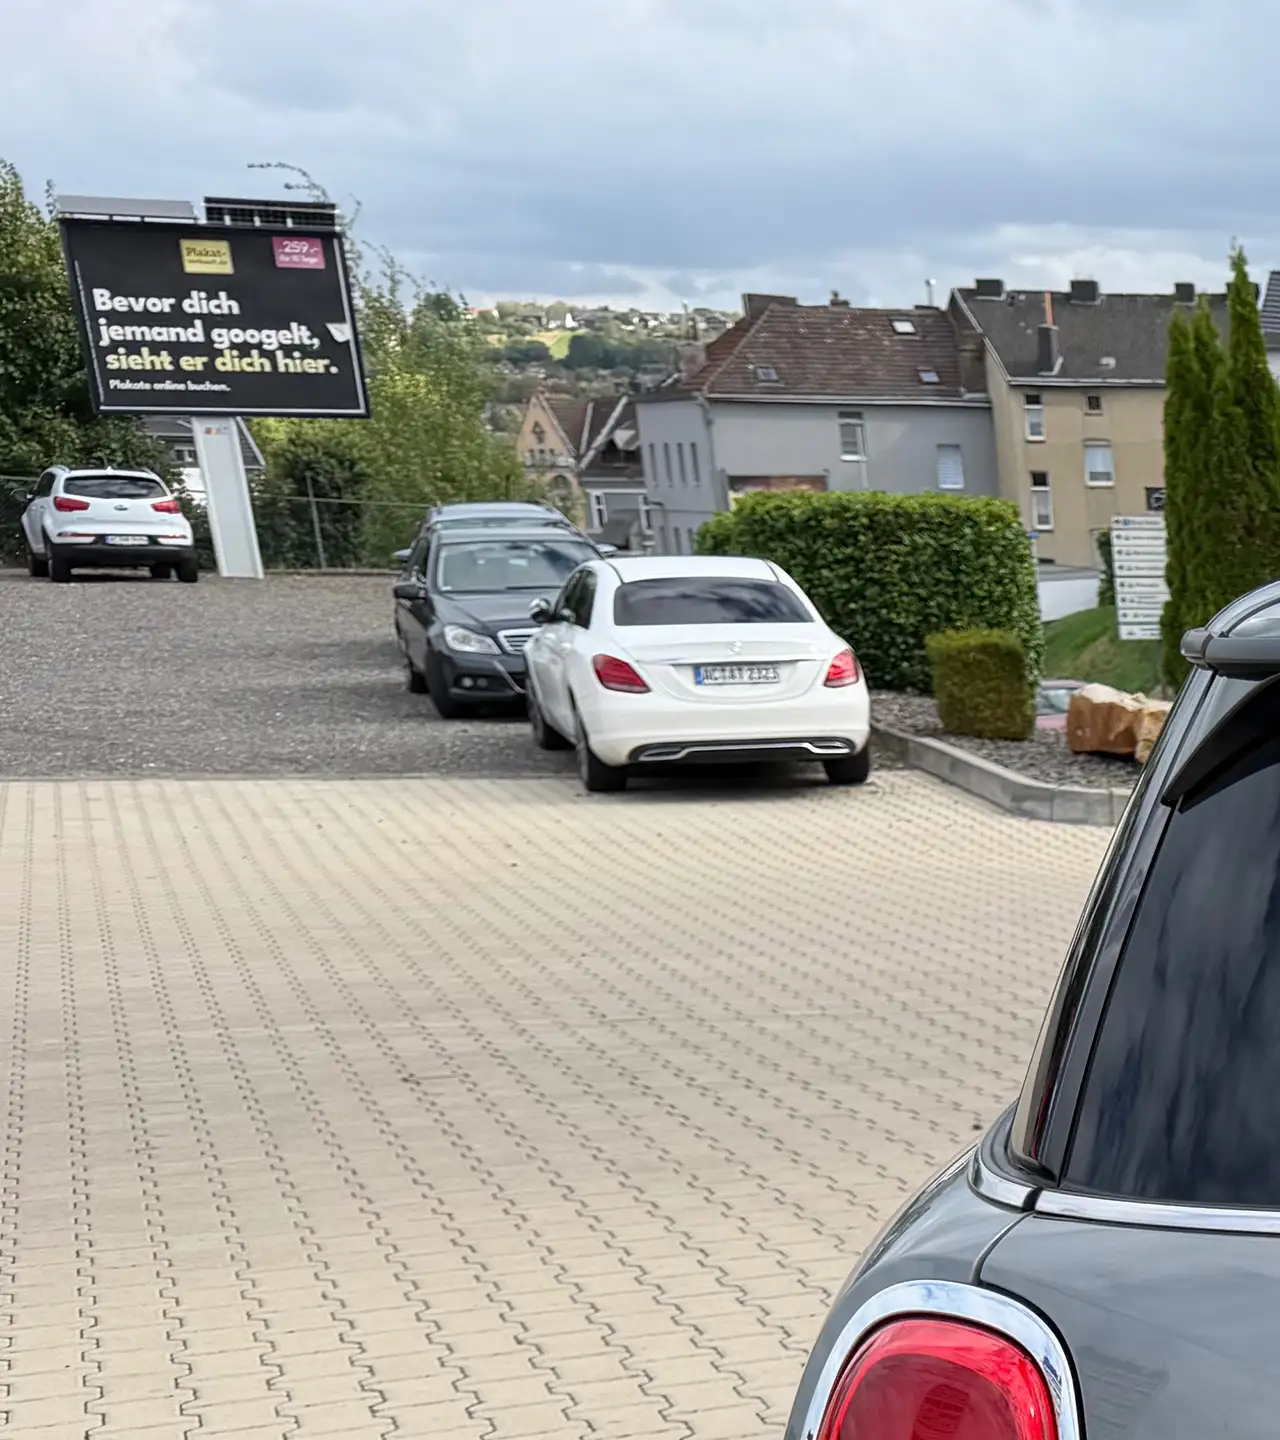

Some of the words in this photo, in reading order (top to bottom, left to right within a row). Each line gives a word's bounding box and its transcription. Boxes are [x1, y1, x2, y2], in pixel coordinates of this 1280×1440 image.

[92, 288, 176, 313] Bevor
[182, 290, 240, 315] dich
[98, 318, 205, 346] jemand
[211, 322, 321, 350] googelt,
[105, 347, 175, 371] sieht
[179, 354, 209, 371] er
[215, 349, 272, 373] dich
[275, 349, 339, 374] hier.
[109, 379, 151, 391] Plakate
[153, 380, 186, 391] online
[187, 381, 232, 393] buchen.
